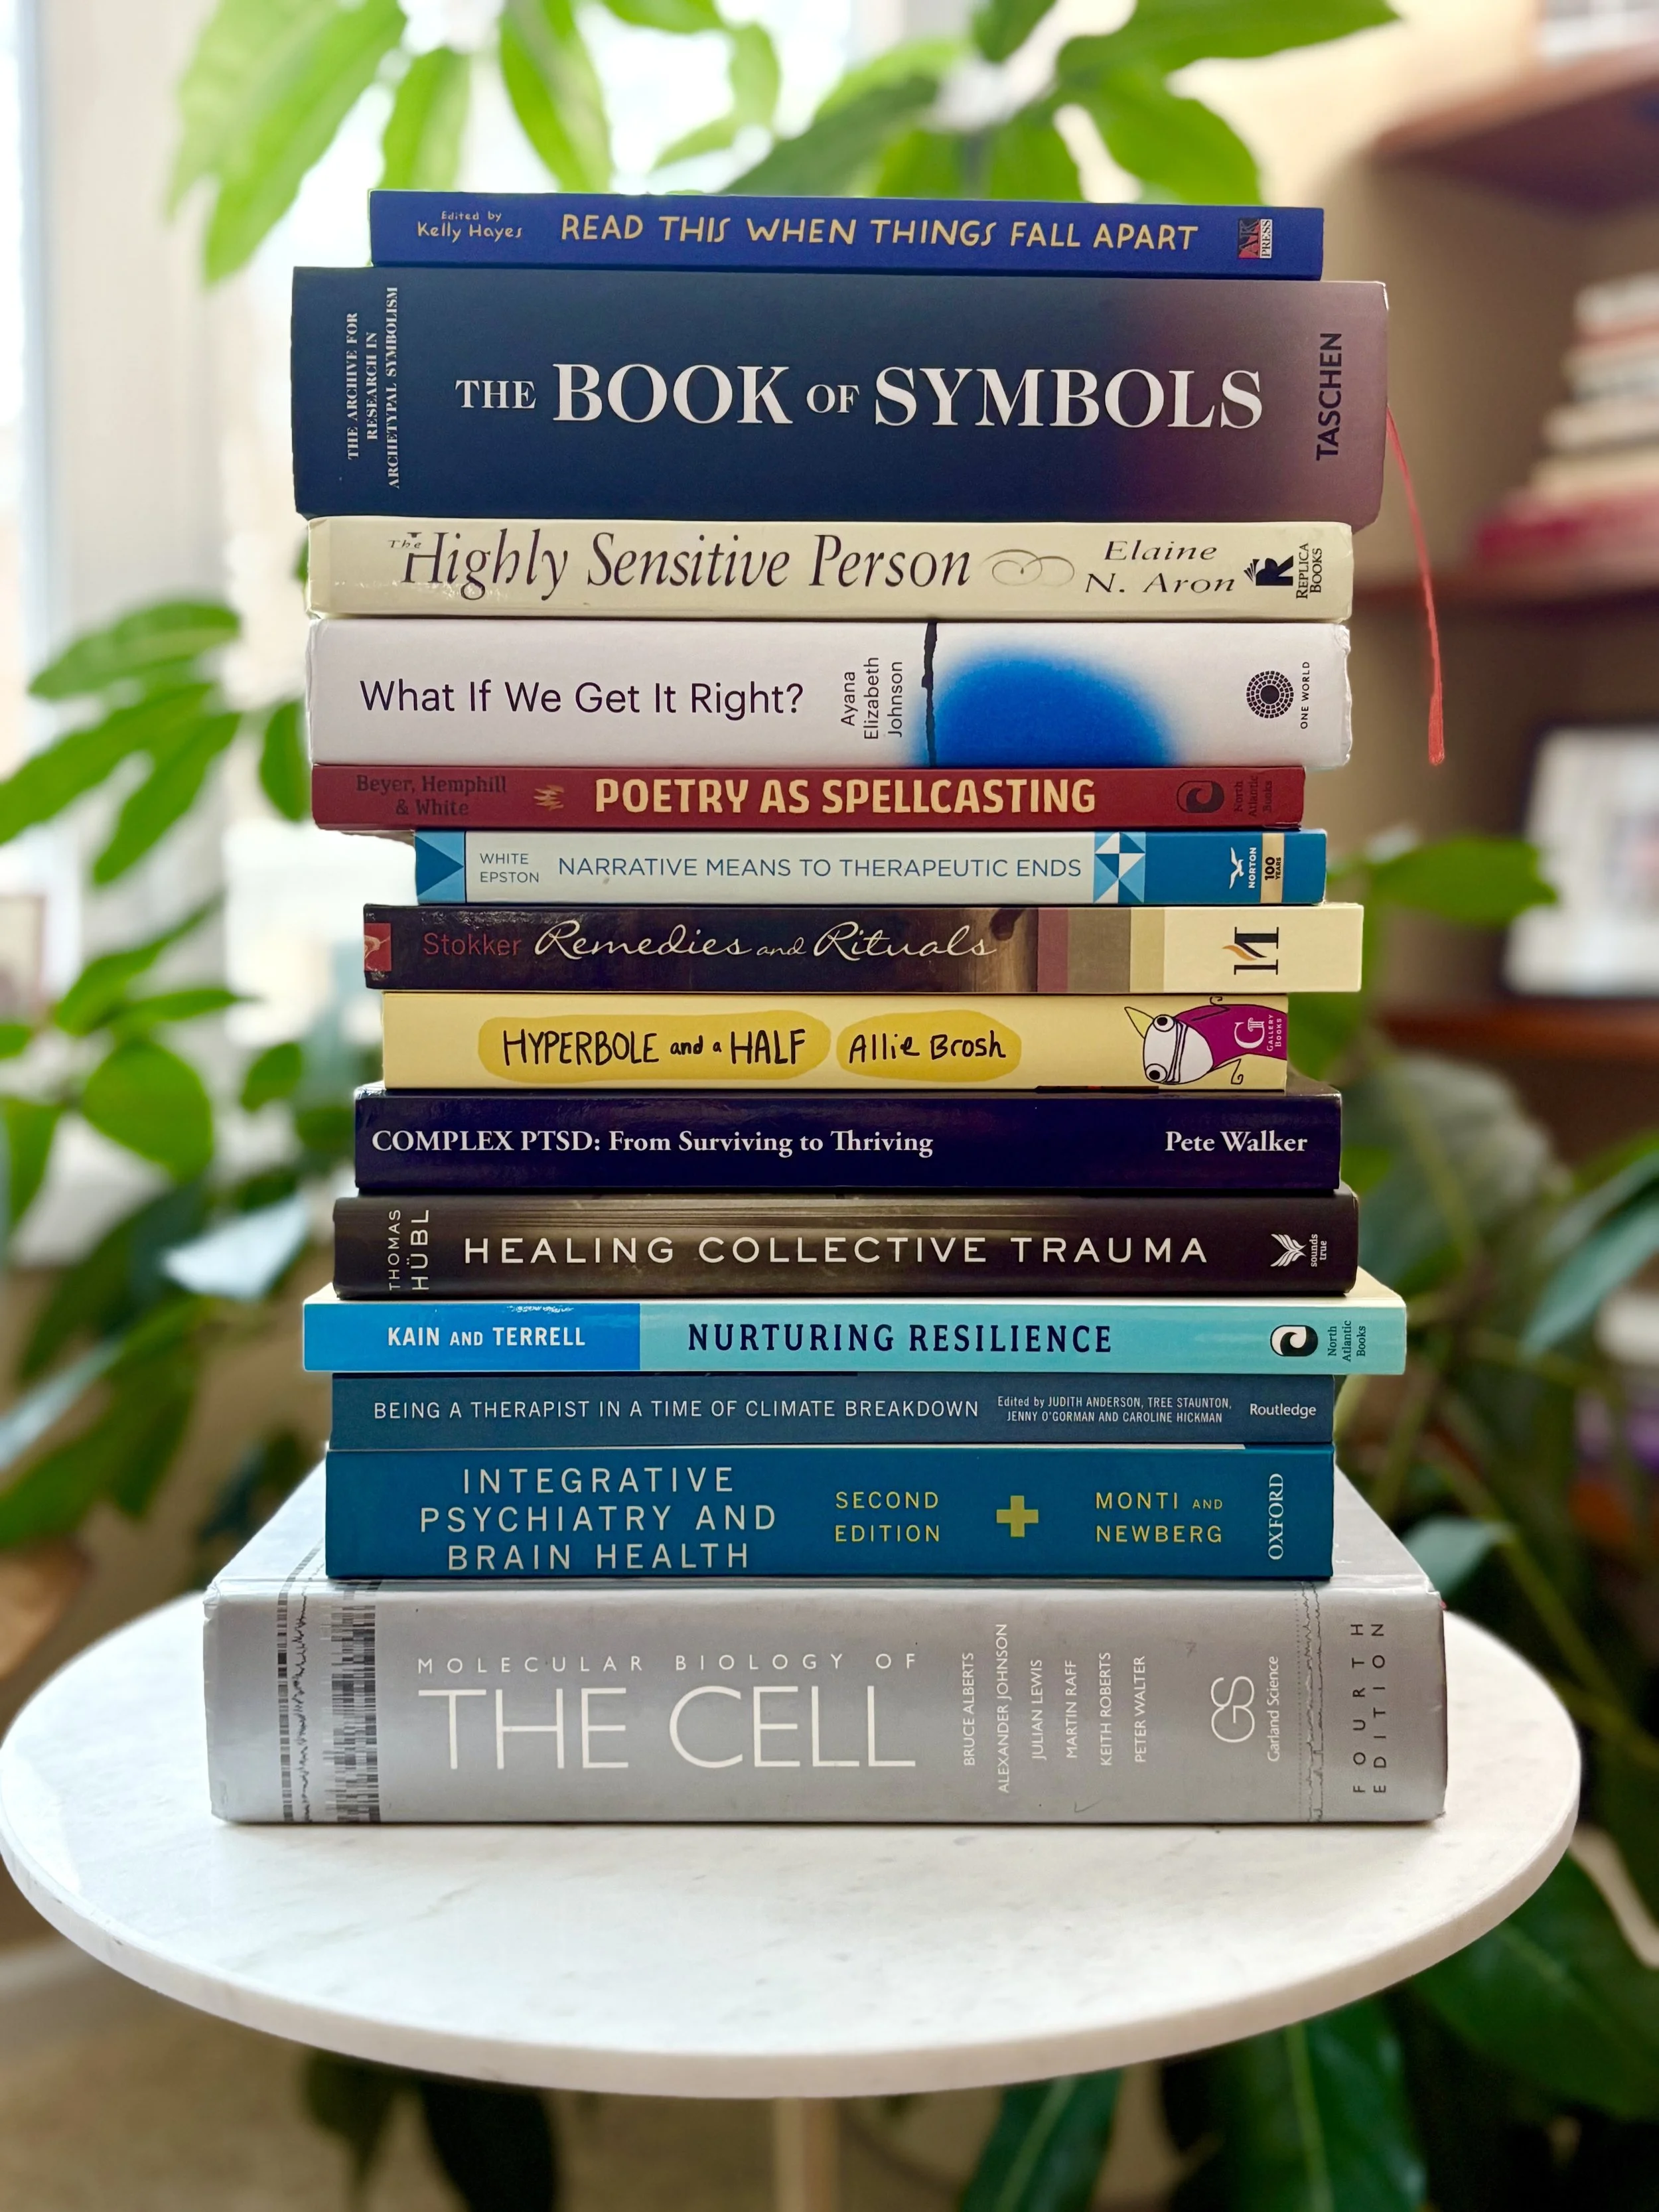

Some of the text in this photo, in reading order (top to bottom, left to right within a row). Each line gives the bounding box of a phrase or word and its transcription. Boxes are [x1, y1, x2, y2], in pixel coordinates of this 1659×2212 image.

[418, 222, 522, 242] Kelly Hayes
[442, 211, 501, 222] Edited by
[562, 214, 1198, 250] READ THIS WHEN THINGS FALL APART
[1262, 220, 1271, 257] PRESS
[346, 313, 358, 459] THE ARCHIVE FOR
[366, 332, 377, 439] RESEARCH IN
[386, 288, 399, 488] ARCHETYPAL SYMBOLISM
[455, 364, 1262, 429] THE BOOK OF SYMBOLS
[1316, 334, 1341, 461] TASCHEN
[390, 528, 970, 601] The Highly Sensitive Person
[1105, 540, 1216, 560] Elaine
[1086, 573, 1234, 593] N. Aron
[360, 679, 803, 721] What If We Get It Right?
[841, 672, 858, 726] Ayana
[863, 658, 879, 739] Elizabeth
[887, 662, 902, 737] Johnson
[357, 774, 506, 796] Beyer, Hemphill
[597, 779, 1094, 813] POETRY AS SPELLCASTING
[396, 798, 468, 816] & White
[480, 853, 528, 864] WHITE
[559, 858, 1080, 877] NARRATIVE MEANS TO THERAPEUTIC ENDS
[1265, 857, 1275, 880] 100
[480, 872, 538, 883] EPSTON
[424, 920, 997, 962] Stokker Remedies and Rituals
[504, 1029, 805, 1066] HYPERBOLE and a HALF
[849, 1030, 1006, 1063] Allie Brosh
[372, 1130, 933, 1157] COMPLEX PTSD: From Surviving to Thriving
[1165, 1130, 1307, 1151] Pete Walker
[388, 1210, 400, 1290] THOMAS
[407, 1210, 429, 1290] HÜBL
[466, 1236, 1206, 1263] HEALING COLLECTIVE TRAUMA
[1309, 1234, 1318, 1266] sounds
[389, 1327, 585, 1345] KAIN AND TERRELL
[689, 1324, 1110, 1353] NURTURING RESILIENCE
[1328, 1327, 1336, 1356] North
[1342, 1321, 1351, 1362] Atlantic
[1356, 1326, 1366, 1357] Books
[375, 1401, 977, 1418] BEING A THERAPIST IN A TIME OF CLIMATE BREAKDOWN
[998, 1396, 1231, 1409] Edited by JUDITH ANDERSON, TREE STAUNTON,
[1007, 1411, 1037, 1421] JENNY
[1099, 1412, 1118, 1422] AND
[1123, 1412, 1172, 1422] CAROLINE
[1177, 1412, 1222, 1422] HICKMAN
[1250, 1404, 1316, 1418] Routledge
[465, 1467, 732, 1493] INTEGRATIVE
[836, 1491, 938, 1509] SECOND
[1096, 1492, 1222, 1509] MONTI AND
[421, 1505, 774, 1532] PSYCHIATRY AND
[1269, 1474, 1283, 1560] OXFORD
[835, 1525, 938, 1542] EDITION
[1097, 1526, 1221, 1542] NEWBERG
[449, 1543, 747, 1570] BRAIN HEALTH
[419, 1654, 914, 1673] MOLECULAR BIOLOGY OF
[962, 1653, 975, 1765] BRUCE ALBERTS
[995, 1625, 1012, 1793] ALEXANDER JOHNSON
[1031, 1660, 1046, 1760] JULIAN LEWIS
[1065, 1660, 1077, 1757] MARTIN RAFF
[1099, 1653, 1112, 1765] KEITH ROBERTS
[1134, 1657, 1146, 1762] PETER WALTER
[1267, 1657, 1279, 1761] Garland Science
[1351, 1625, 1366, 1792] FOURTH
[1371, 1625, 1386, 1793] EDITION
[419, 1686, 915, 1769] THE CELL
